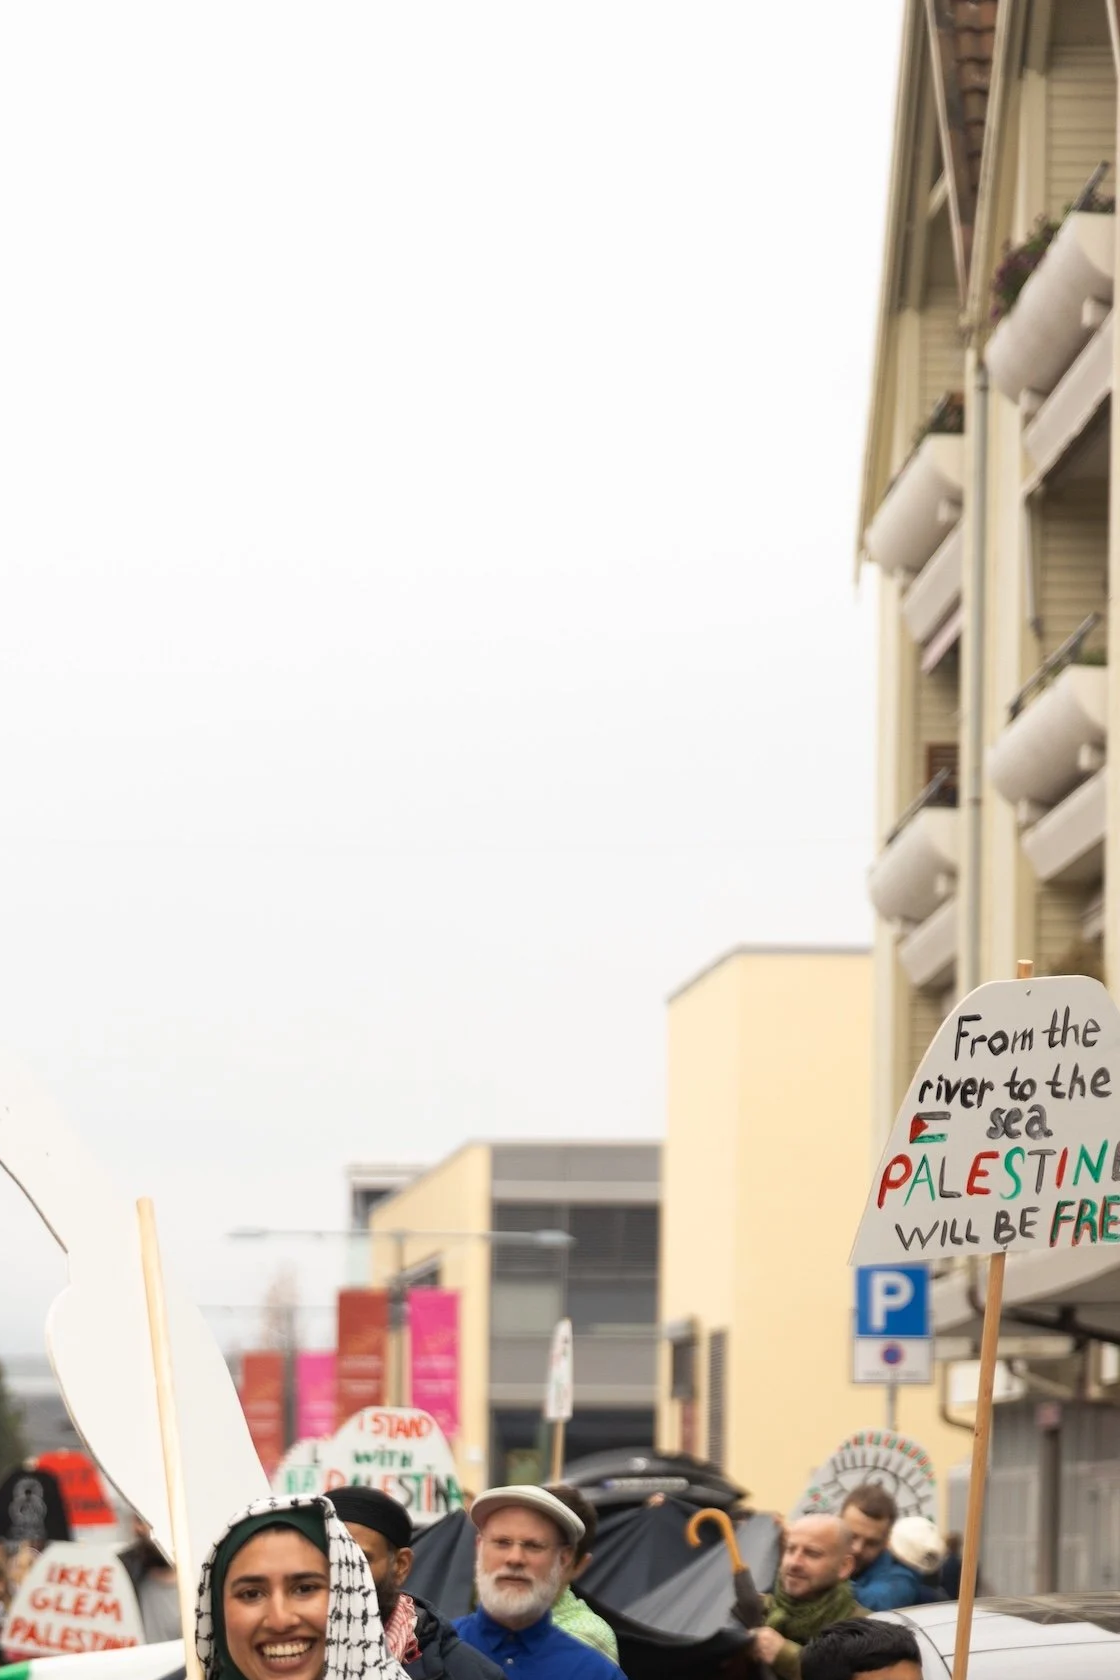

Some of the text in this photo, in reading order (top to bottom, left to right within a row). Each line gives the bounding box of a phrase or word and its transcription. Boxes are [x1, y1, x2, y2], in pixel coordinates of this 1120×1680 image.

[954, 1005, 1101, 1061] From the
[918, 1062, 1112, 1109] river to the
[986, 1104, 1054, 1141] sea
[895, 1218, 980, 1251] WILL
[993, 1207, 1040, 1245] BE
[869, 1271, 914, 1331] P
[372, 1413, 433, 1438] STAND
[353, 1449, 413, 1467] WITH
[47, 1562, 114, 1593] IKKE
[29, 1587, 122, 1622] GLEM
